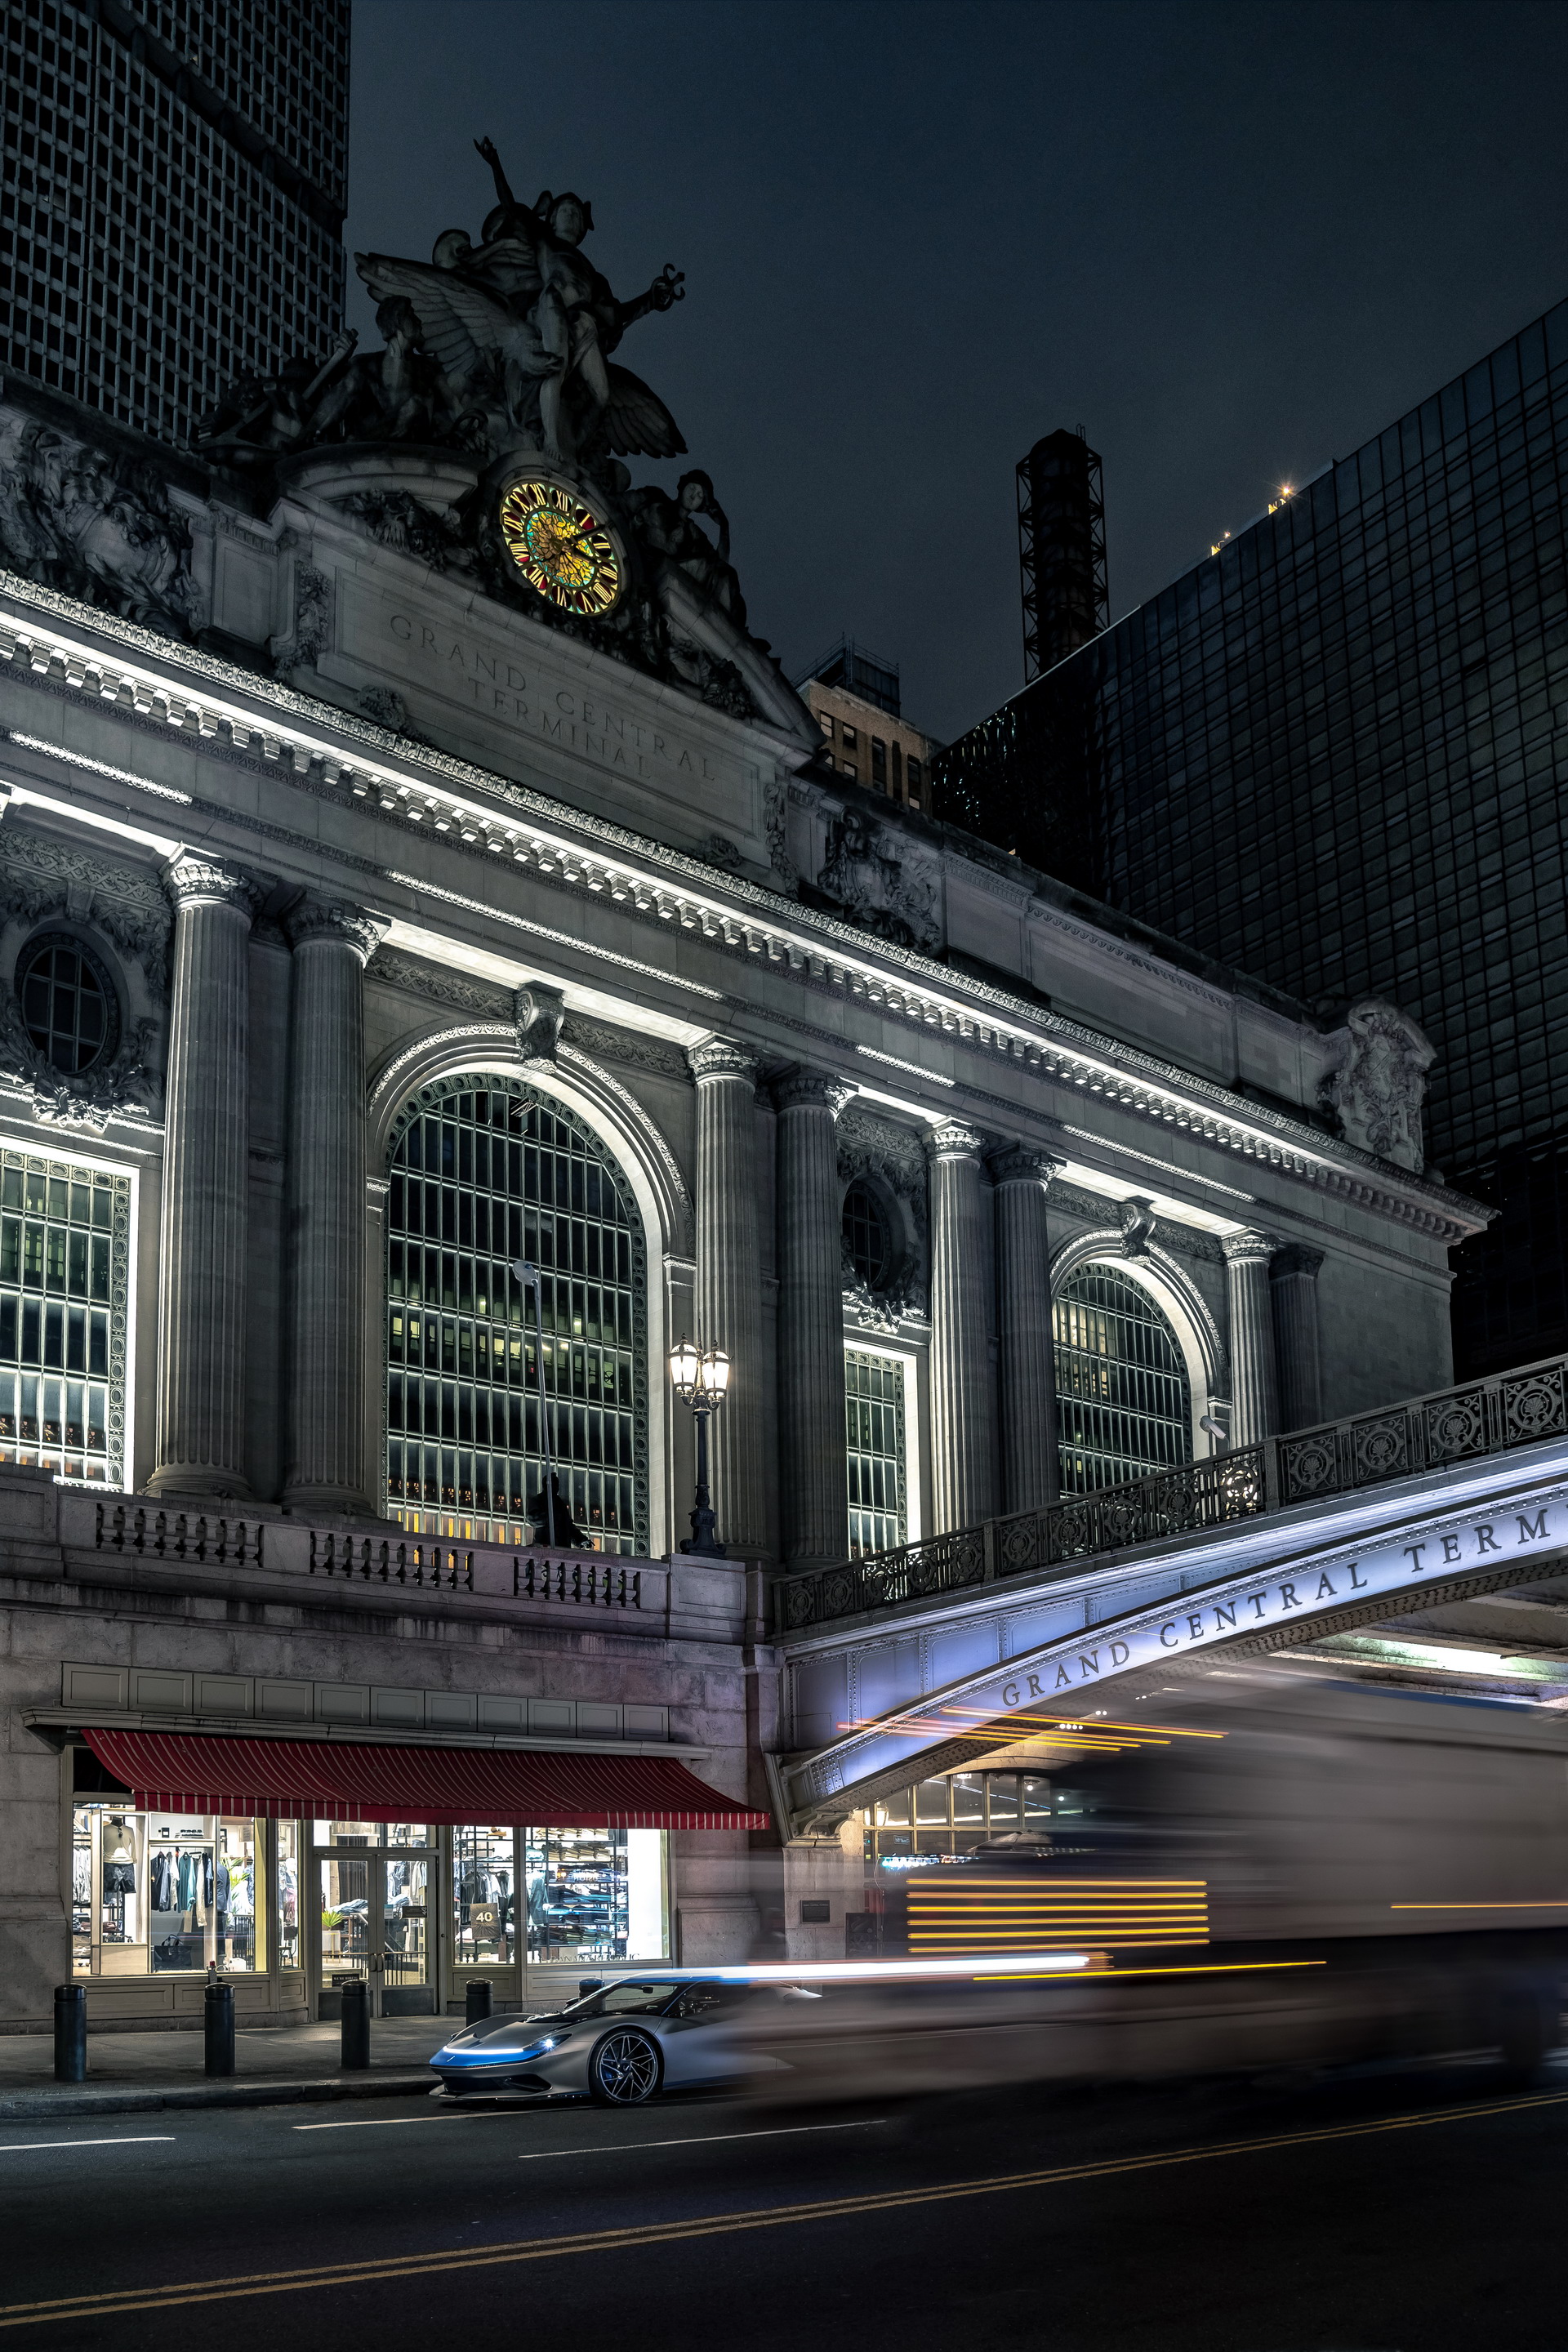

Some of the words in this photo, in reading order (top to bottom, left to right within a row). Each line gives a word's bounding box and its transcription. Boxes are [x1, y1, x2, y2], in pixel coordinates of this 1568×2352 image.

[510, 492, 530, 514] X
[555, 489, 568, 512] XII
[504, 514, 523, 535] IX
[579, 514, 590, 527] I
[599, 565, 617, 581] III
[582, 592, 595, 612] V
[390, 615, 527, 692] GRAND
[555, 690, 716, 782] CENTRAL
[468, 676, 652, 779] TERMINAL
[1002, 1640, 1130, 1708] GRAND
[1159, 1561, 1369, 1649] CENTRAL
[1402, 1505, 1568, 1573] TERM
[487, 1811, 556, 1824] REPUBLIC
